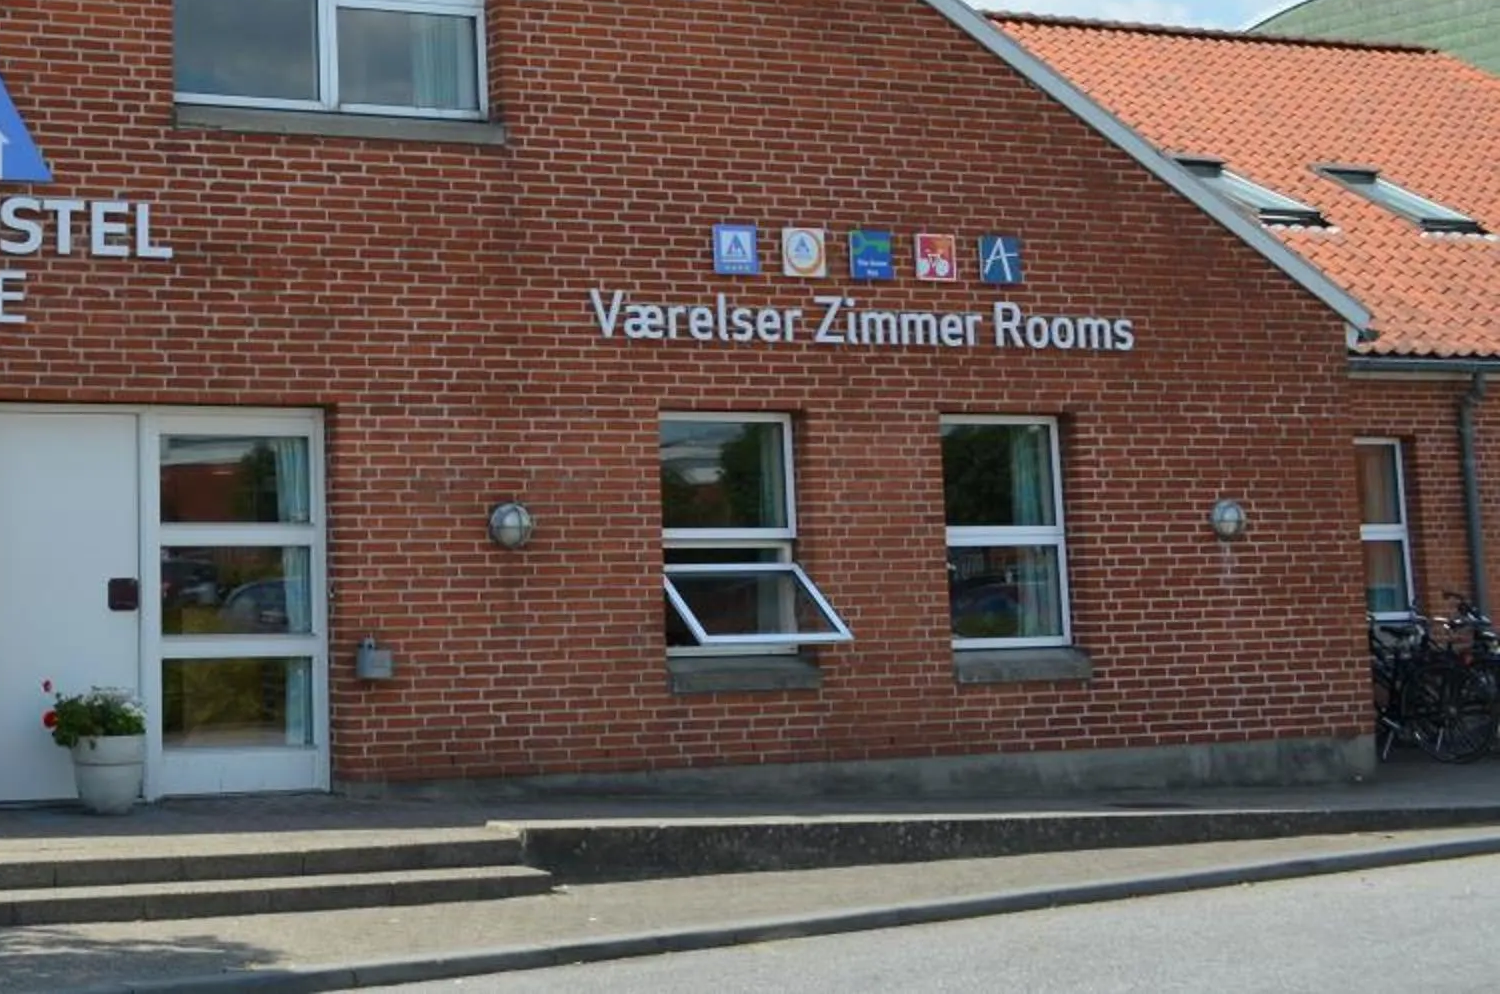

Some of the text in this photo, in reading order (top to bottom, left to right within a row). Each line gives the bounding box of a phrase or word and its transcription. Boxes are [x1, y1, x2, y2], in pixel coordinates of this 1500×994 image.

[590, 288, 1135, 351] Værelser Zimmer Rooms
